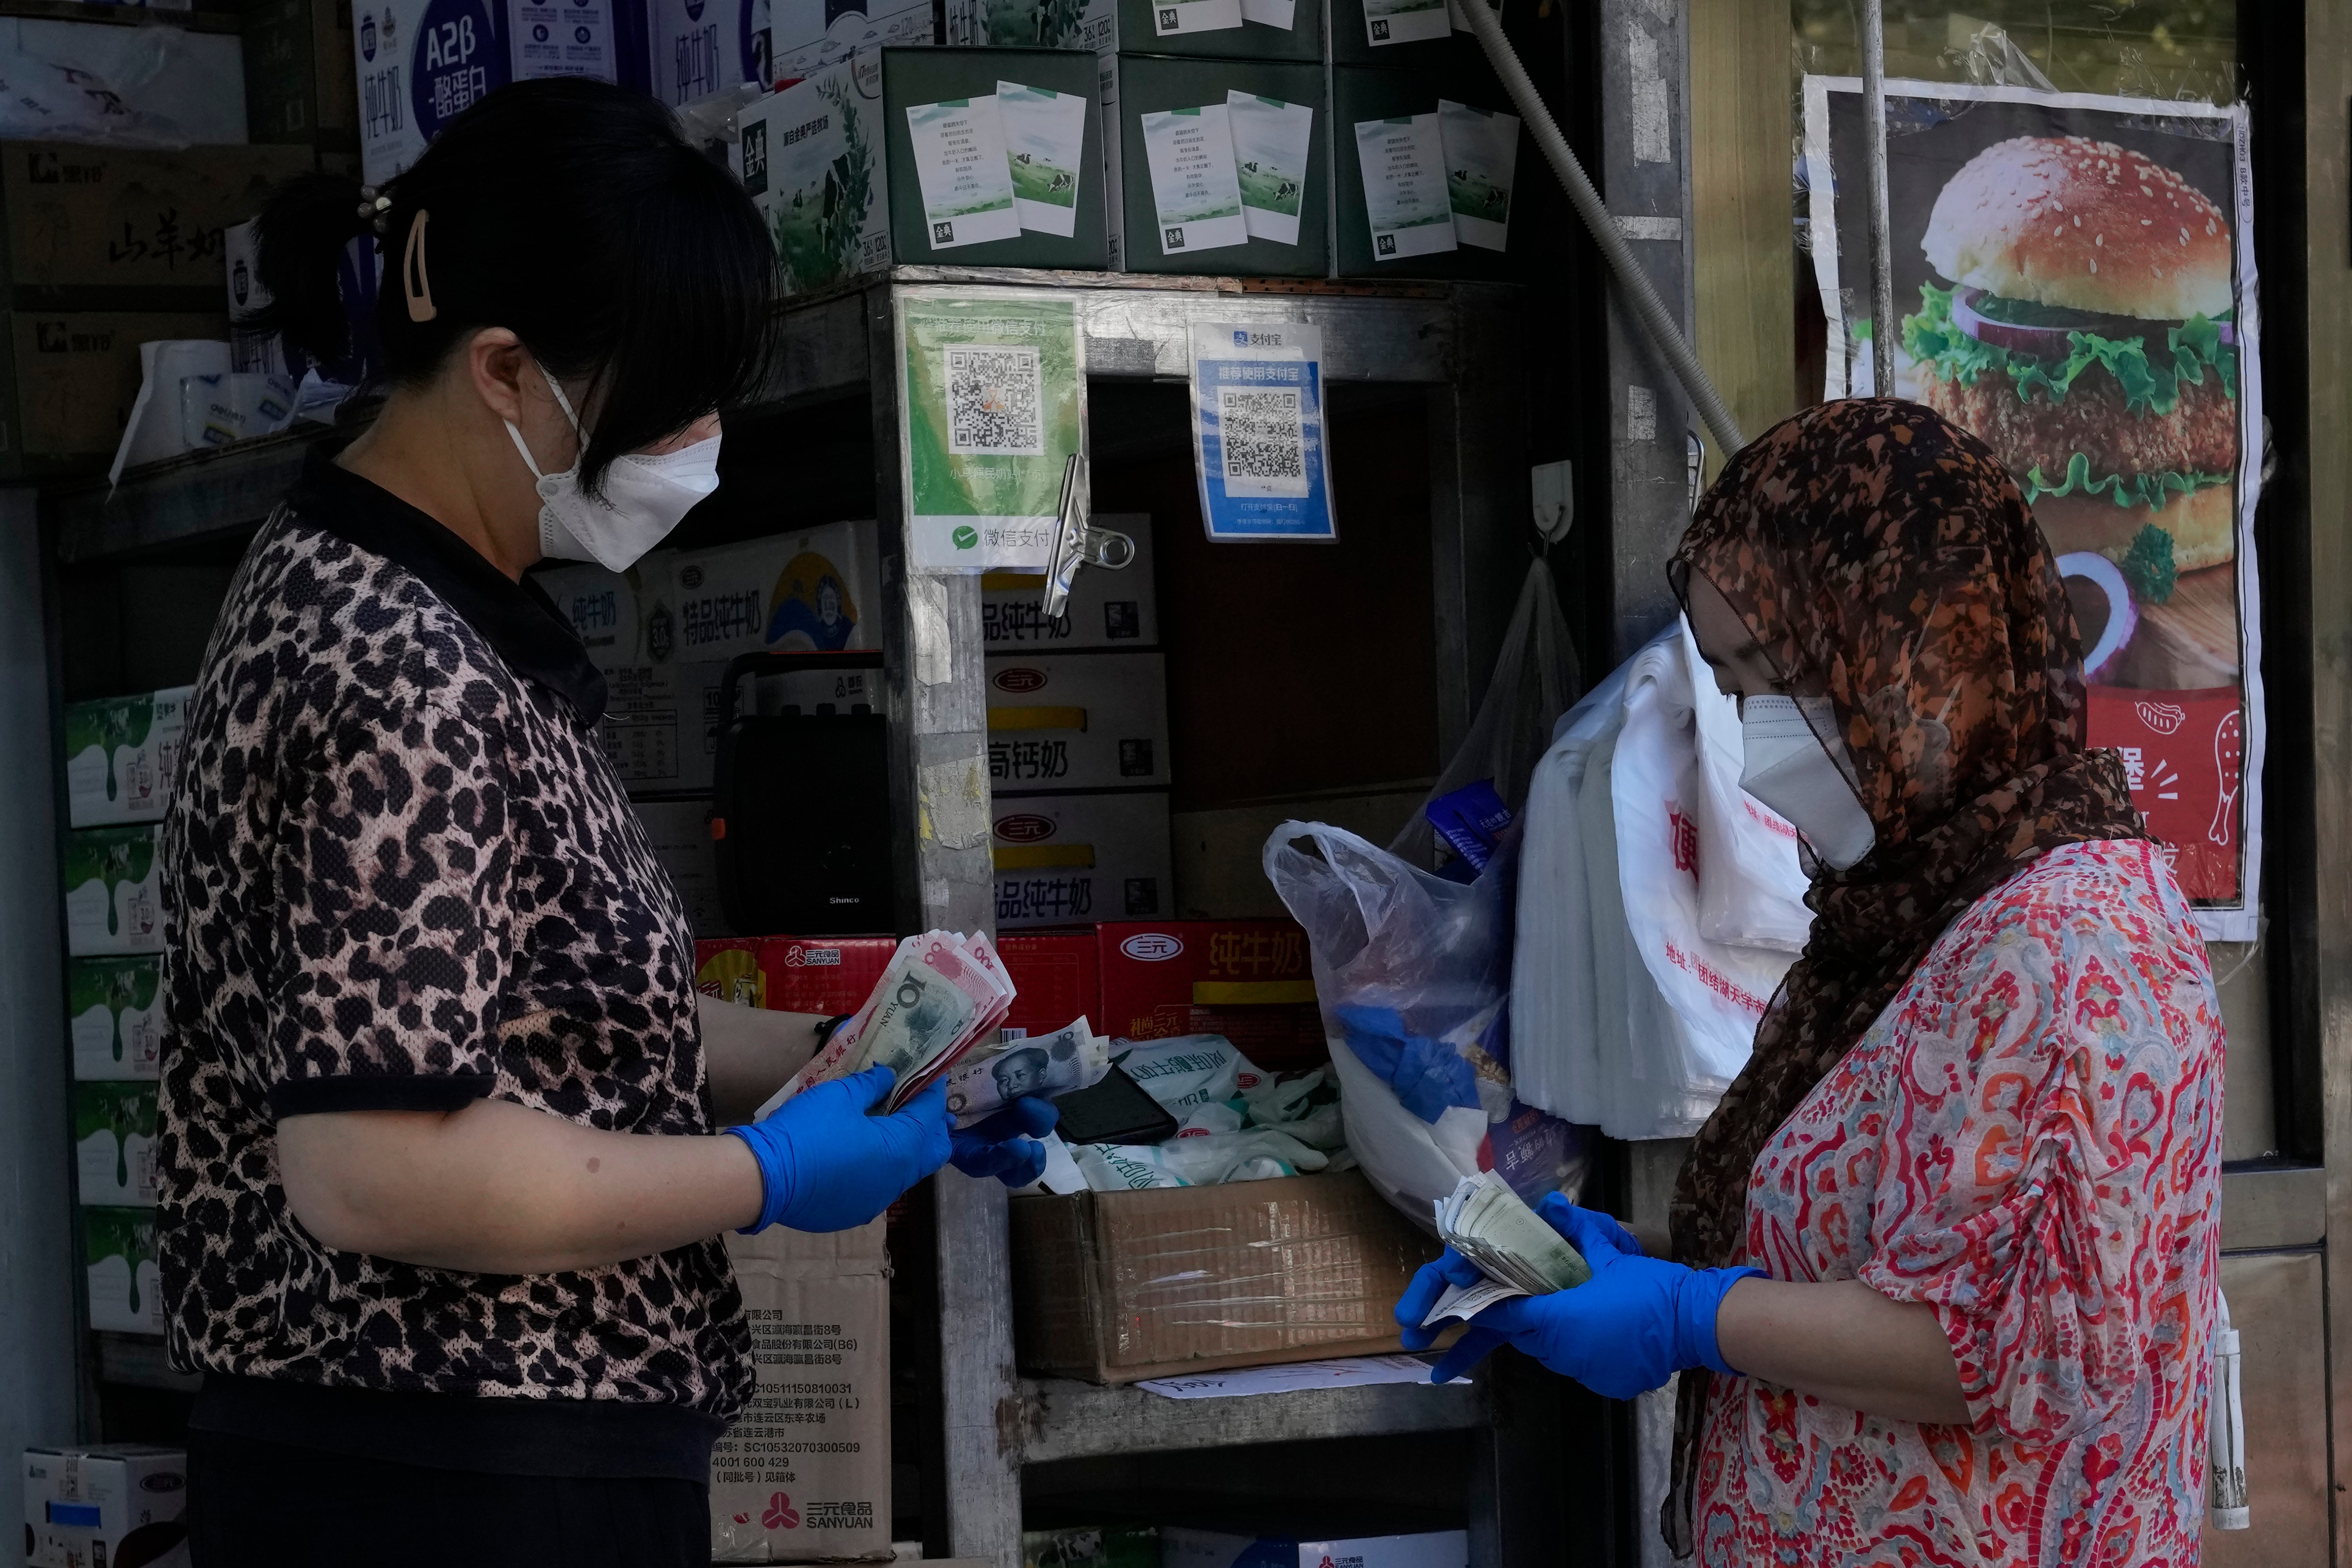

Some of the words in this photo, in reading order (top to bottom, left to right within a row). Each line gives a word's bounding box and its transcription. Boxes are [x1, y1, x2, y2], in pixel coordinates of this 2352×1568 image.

[1161, 12, 1177, 25] 金典
[1373, 24, 1389, 36] 金典
[745, 129, 766, 178] 金典
[936, 225, 953, 238] 金典
[1167, 231, 1183, 243] 金典
[1379, 238, 1395, 251] 金典
[1250, 334, 1281, 346] 支付宝
[1219, 366, 1299, 381] 推荐使用支付宝
[984, 529, 1049, 547] 微信支付
[683, 589, 761, 647] 特品纯牛奶
[1007, 674, 1034, 686] 三元
[988, 740, 1068, 780] 高钙奶
[1009, 822, 1040, 835] 三元
[995, 877, 1091, 919] 品纯牛奶
[1137, 941, 1167, 953] 三元
[1209, 931, 1303, 975] 纯牛奶
[896, 969, 927, 1009] 10
[880, 1001, 899, 1028] YUAN
[795, 1033, 857, 1095] 中国人民银行
[747, 1325, 841, 1335] 兴区瀛海瀛昌街8号
[744, 1442, 860, 1452] SC10532070300509
[712, 1457, 740, 1467] 4001
[744, 1457, 765, 1467] 600
[768, 1457, 789, 1467] 429
[806, 1502, 873, 1516] 三元食品
[806, 1517, 873, 1528] SANYUAN
